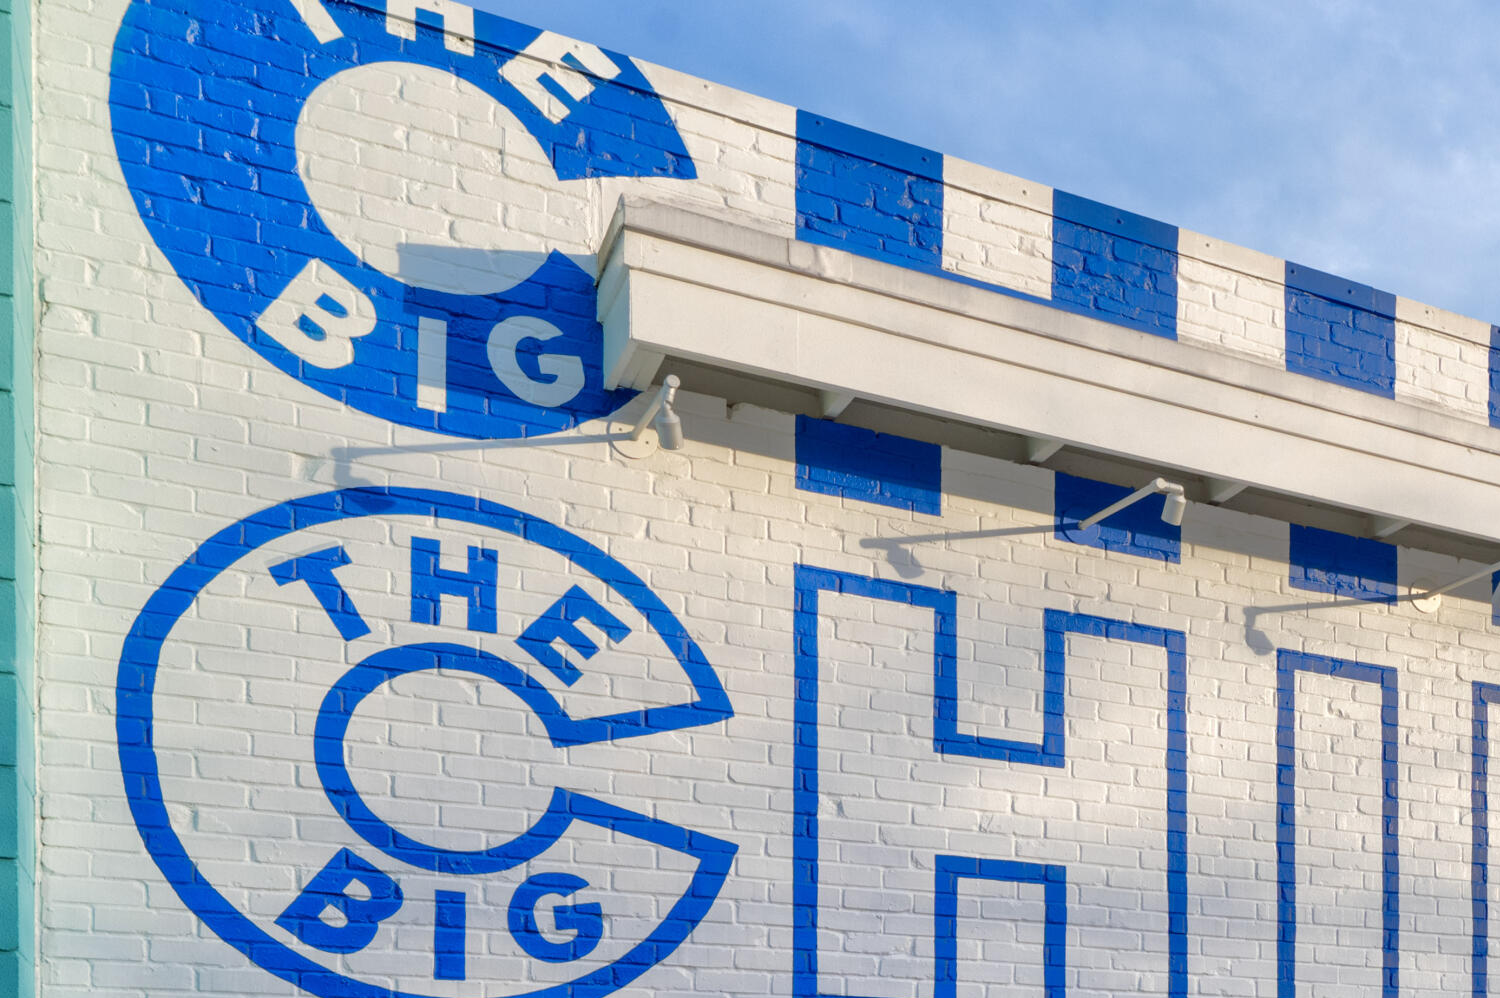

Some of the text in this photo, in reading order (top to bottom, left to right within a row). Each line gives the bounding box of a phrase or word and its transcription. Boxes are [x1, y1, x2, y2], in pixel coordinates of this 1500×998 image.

[256, 258, 586, 413] BIG
[267, 536, 631, 688] THE
[274, 847, 604, 981] BIG
